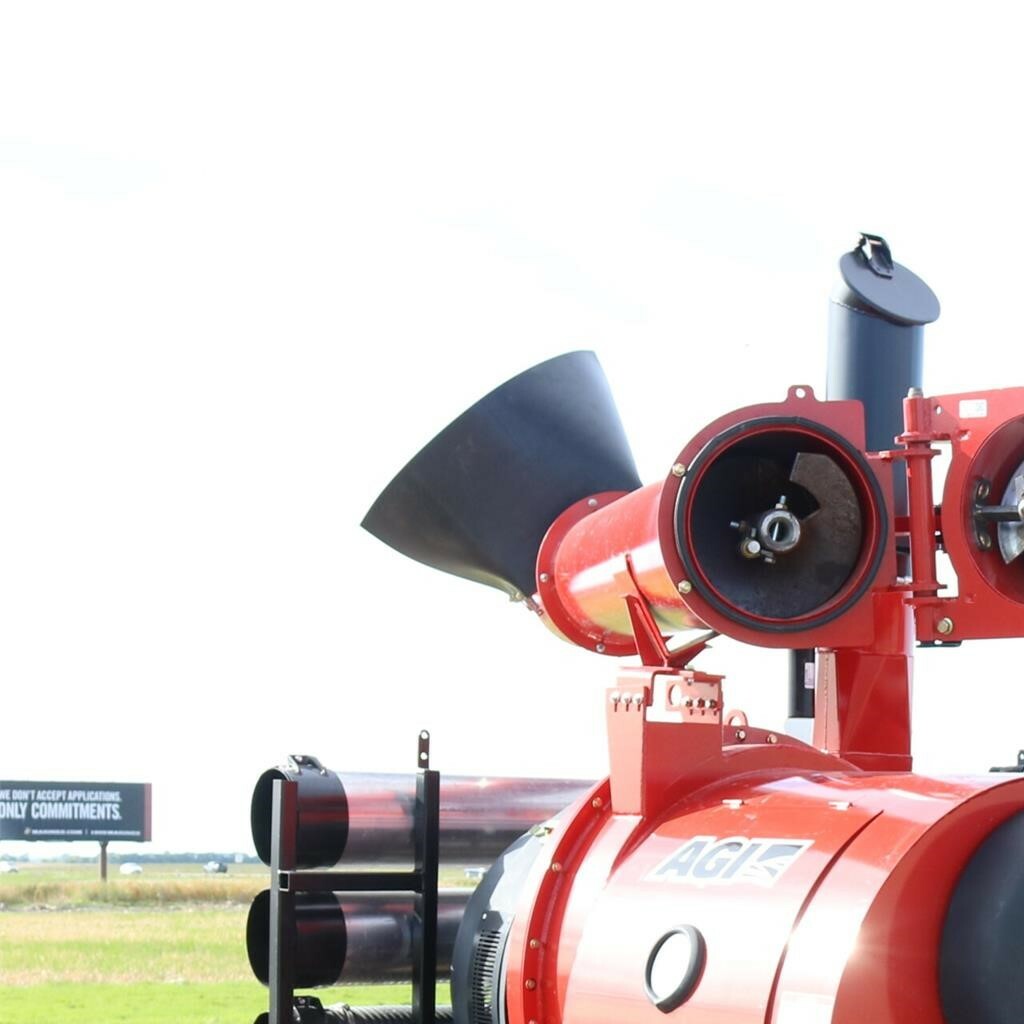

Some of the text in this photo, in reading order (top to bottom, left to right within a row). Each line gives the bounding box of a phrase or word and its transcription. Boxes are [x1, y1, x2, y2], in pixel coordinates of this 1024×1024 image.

[12, 789, 36, 800] DON'T
[36, 790, 67, 801] ACCEPT
[67, 790, 122, 802] APPLICATIONS.
[0, 802, 122, 820] ONLY COMMITMENTS.
[655, 840, 757, 880] AGI
